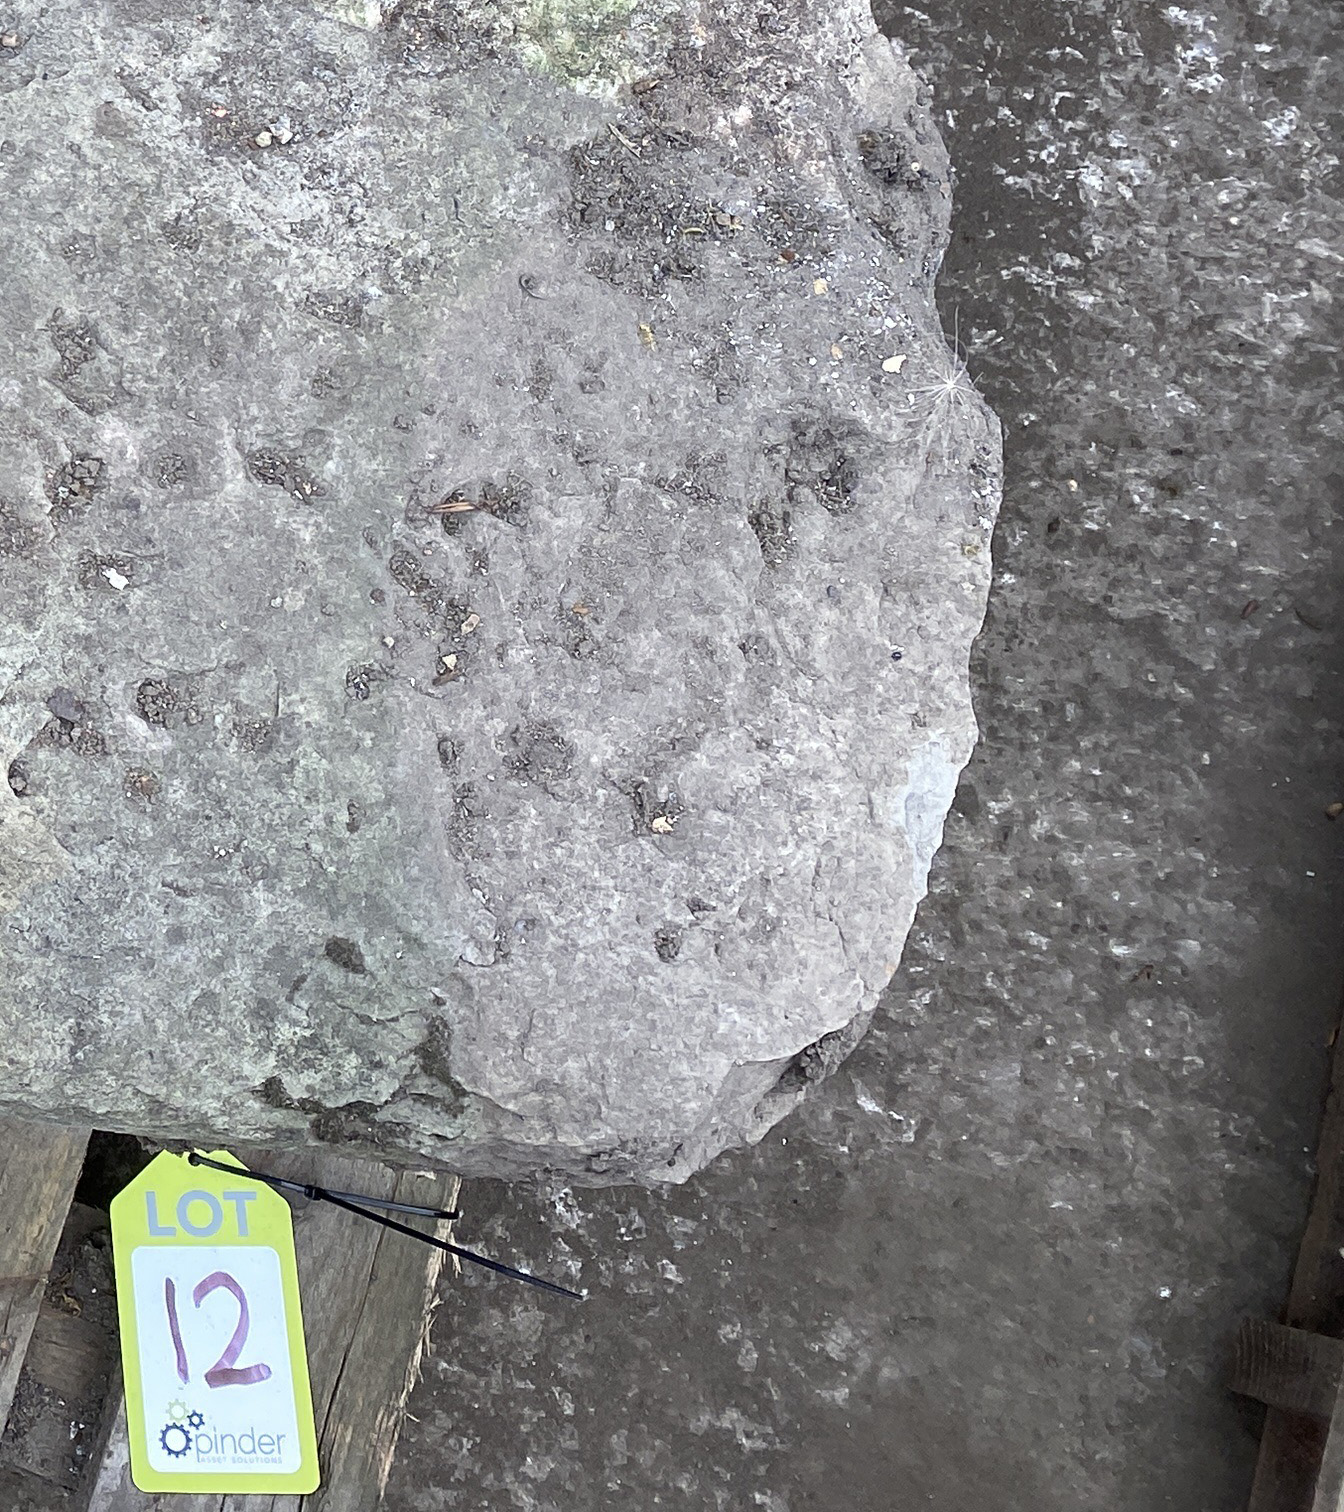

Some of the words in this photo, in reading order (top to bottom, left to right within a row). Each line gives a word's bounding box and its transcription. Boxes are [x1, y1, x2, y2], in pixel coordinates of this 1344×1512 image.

[145, 1189, 257, 1238] LOT
[164, 1271, 272, 1389] 12
[195, 1426, 286, 1463] pinder
[201, 1456, 227, 1464] ASSET
[232, 1456, 283, 1465] SOLUTIONS
